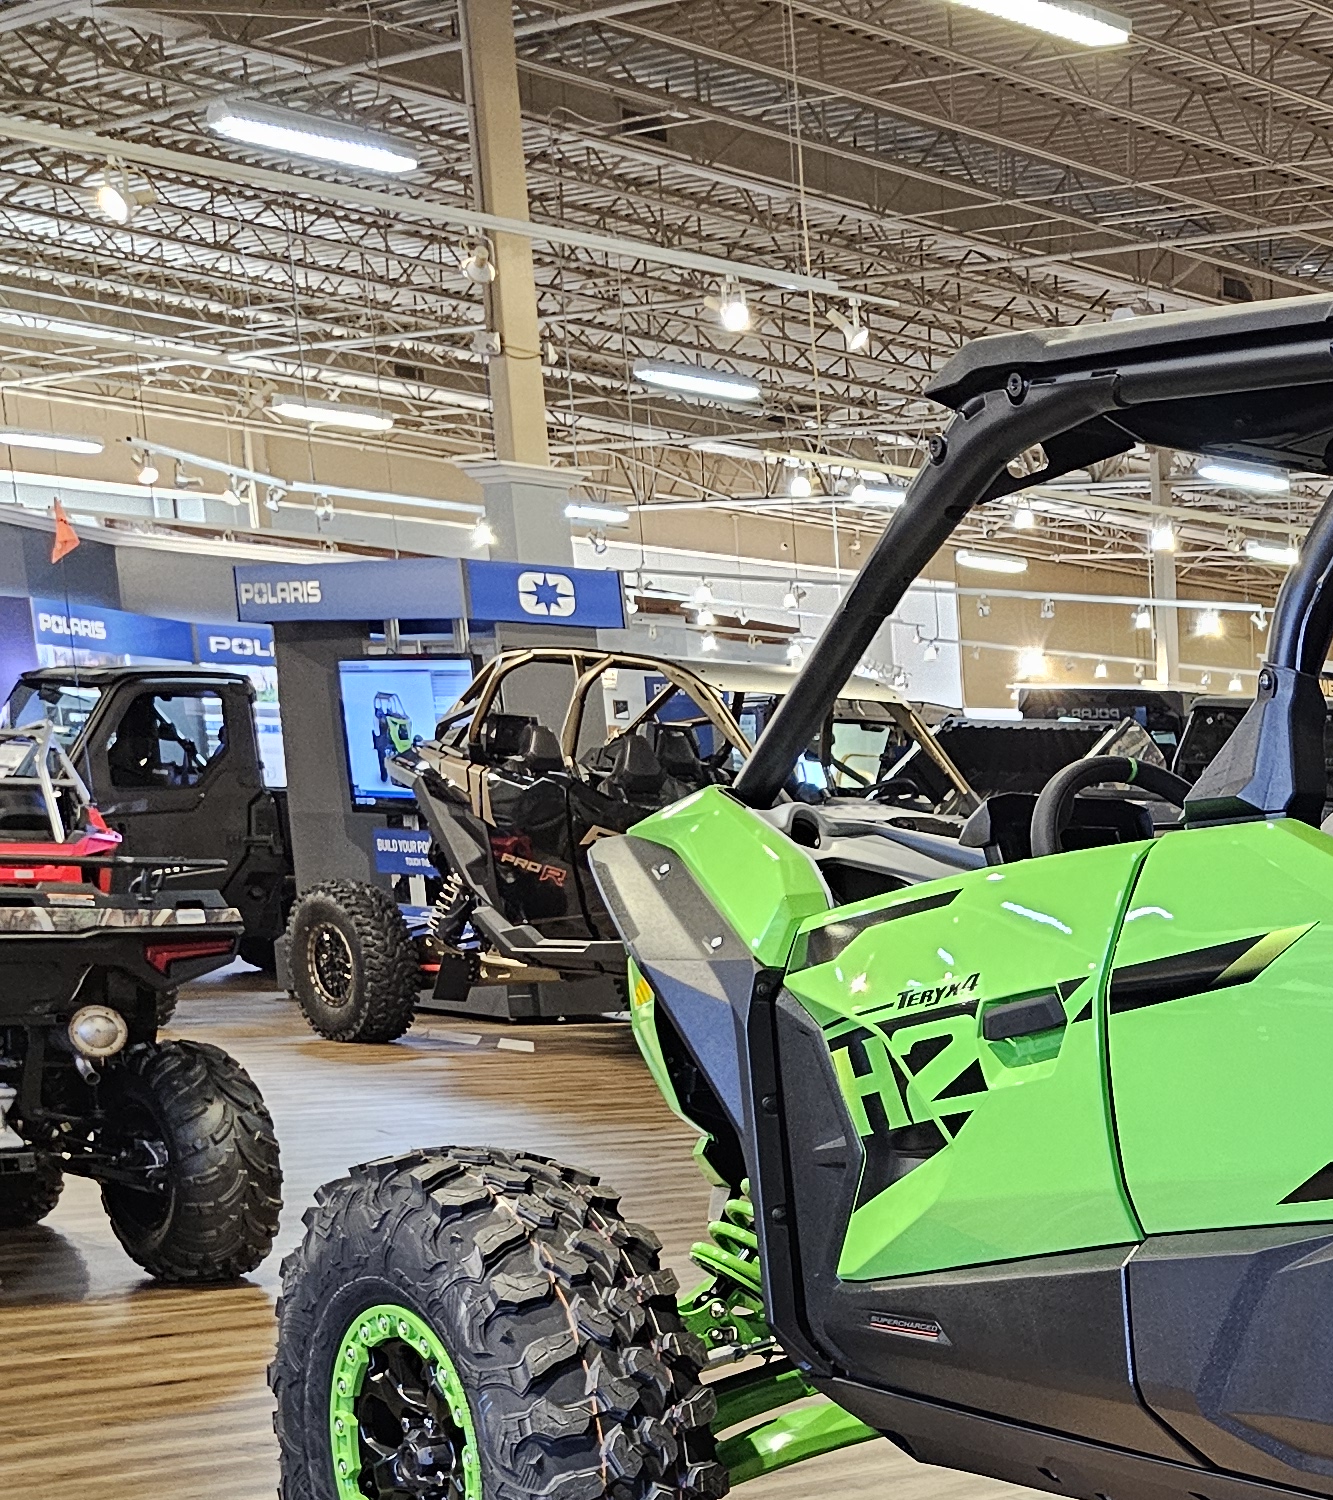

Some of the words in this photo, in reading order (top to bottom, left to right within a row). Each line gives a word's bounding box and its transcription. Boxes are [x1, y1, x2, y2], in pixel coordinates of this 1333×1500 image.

[240, 580, 322, 605] POLARIS
[38, 612, 106, 640] POLARIS
[209, 636, 275, 658] POL
[501, 853, 542, 873] PRO
[870, 1315, 938, 1332] SUPERCHARGED
